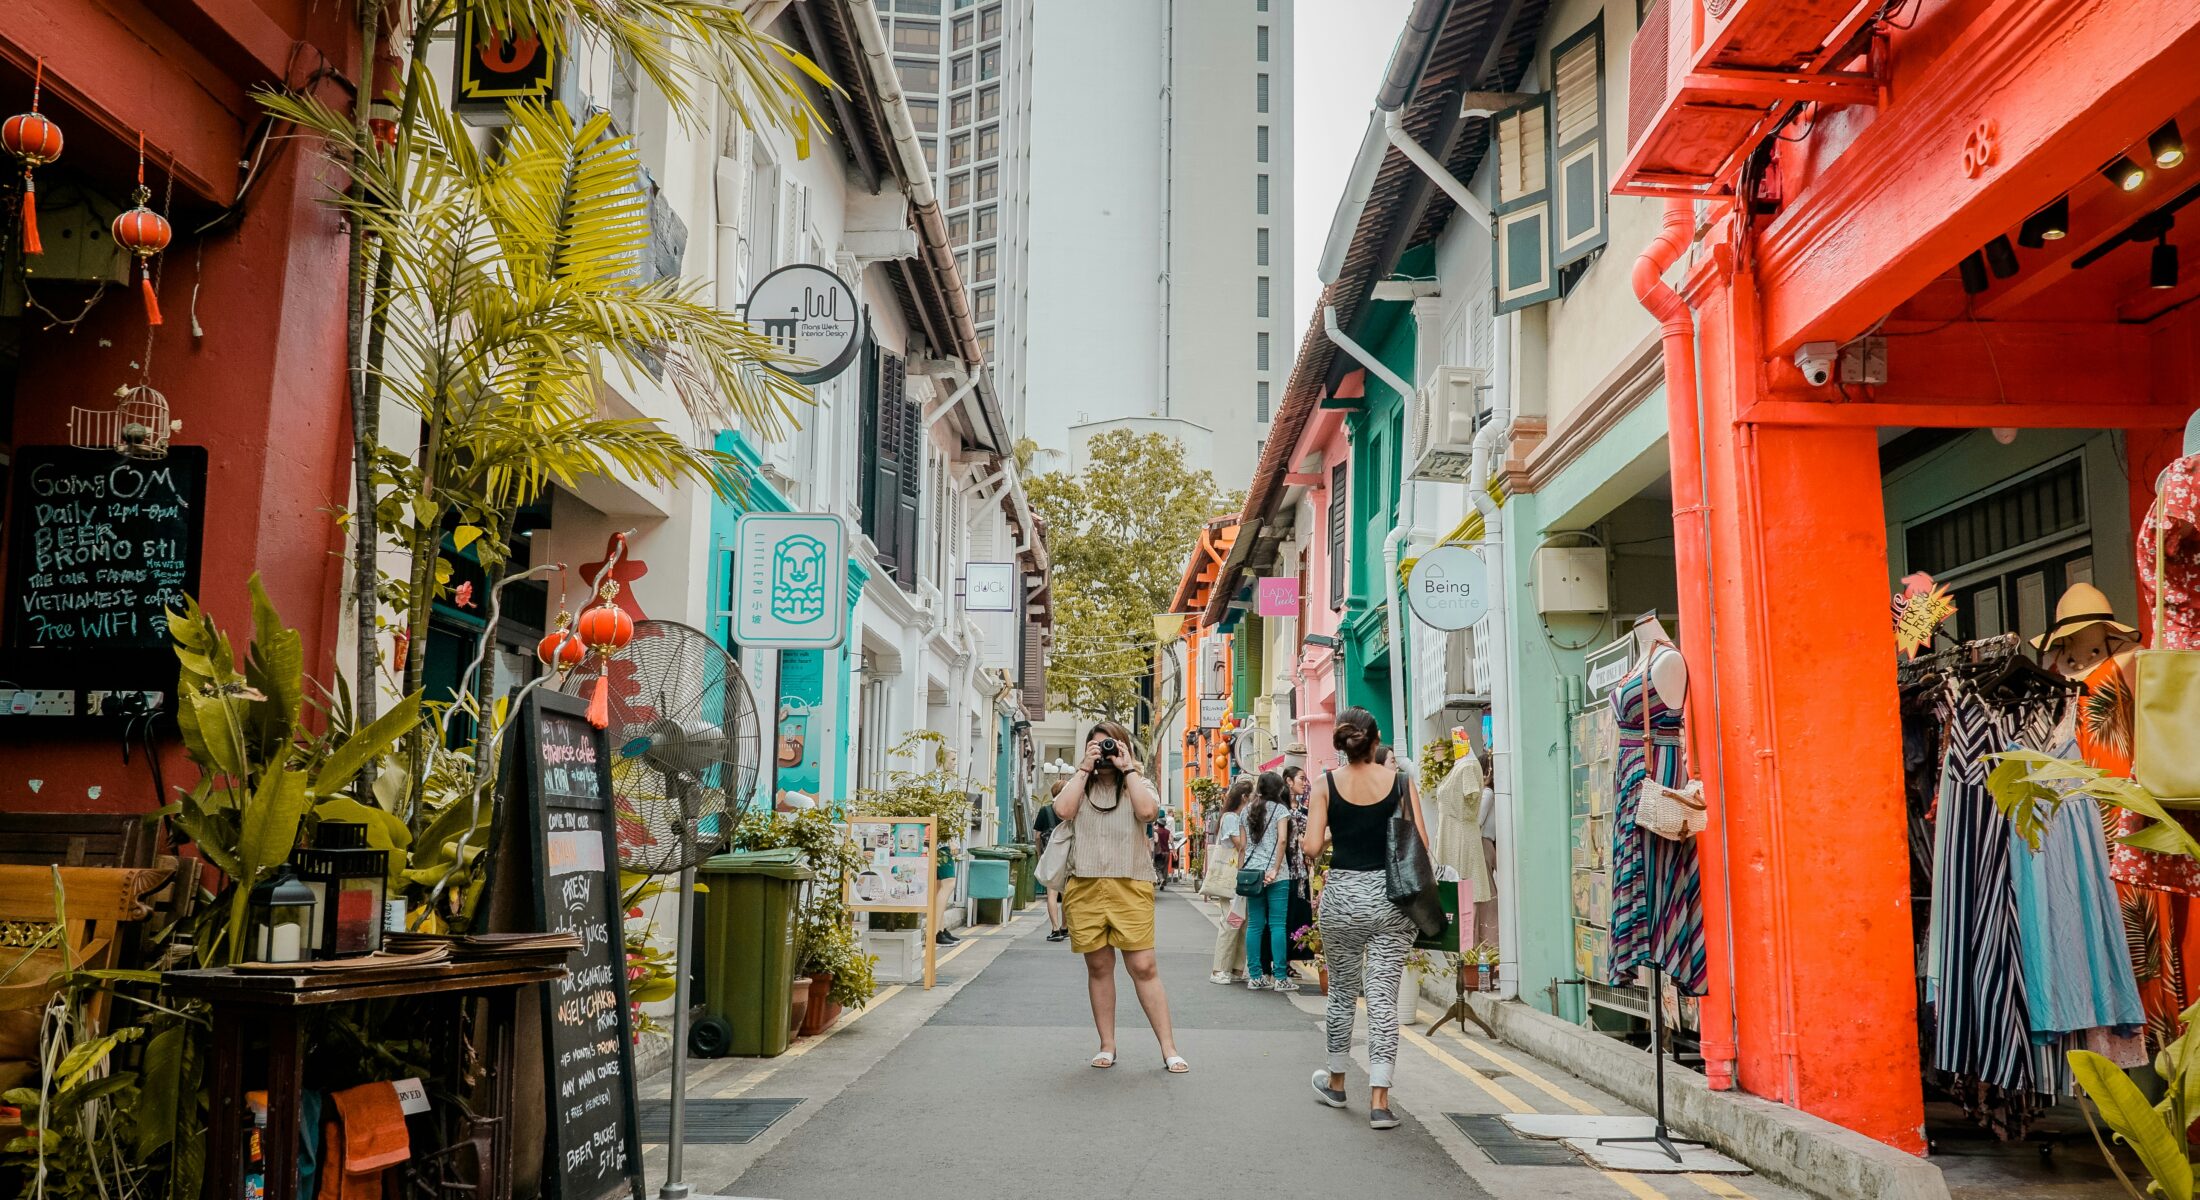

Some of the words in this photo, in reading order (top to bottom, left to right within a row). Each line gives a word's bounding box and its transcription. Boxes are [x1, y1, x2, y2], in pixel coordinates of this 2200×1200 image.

[1962, 120, 1990, 178] 68
[826, 330, 848, 339] Design
[31, 463, 104, 498] Going
[35, 500, 97, 526] Daily
[34, 523, 117, 554] BEER
[36, 540, 132, 571] PROMO
[29, 573, 53, 588] THE
[96, 569, 148, 583] FAMOUS
[1425, 580, 1470, 597] Being
[23, 589, 137, 612] VIETNAMESE
[144, 588, 183, 607] coffee
[1262, 588, 1293, 598] LADY
[1426, 596, 1480, 609] Centre
[29, 614, 75, 642] Free
[81, 612, 137, 638] WIFI
[1902, 606, 1919, 625] FOR
[1913, 614, 1930, 631] FOR
[1897, 625, 1908, 636] 1
[575, 735, 597, 763] coffee
[548, 813, 564, 830] COME
[564, 812, 575, 829] TRY
[577, 814, 589, 828] OUR
[583, 916, 608, 956] juices
[577, 964, 613, 991] SIGNATURE
[586, 989, 616, 1018] CHAKRA
[562, 1077, 575, 1098] ANY
[578, 1068, 595, 1091] MAIN
[597, 1061, 620, 1080] COURSE
[571, 1104, 583, 1119] FREE
[567, 1140, 593, 1173] BEER
[593, 1122, 616, 1147] BUCKET
